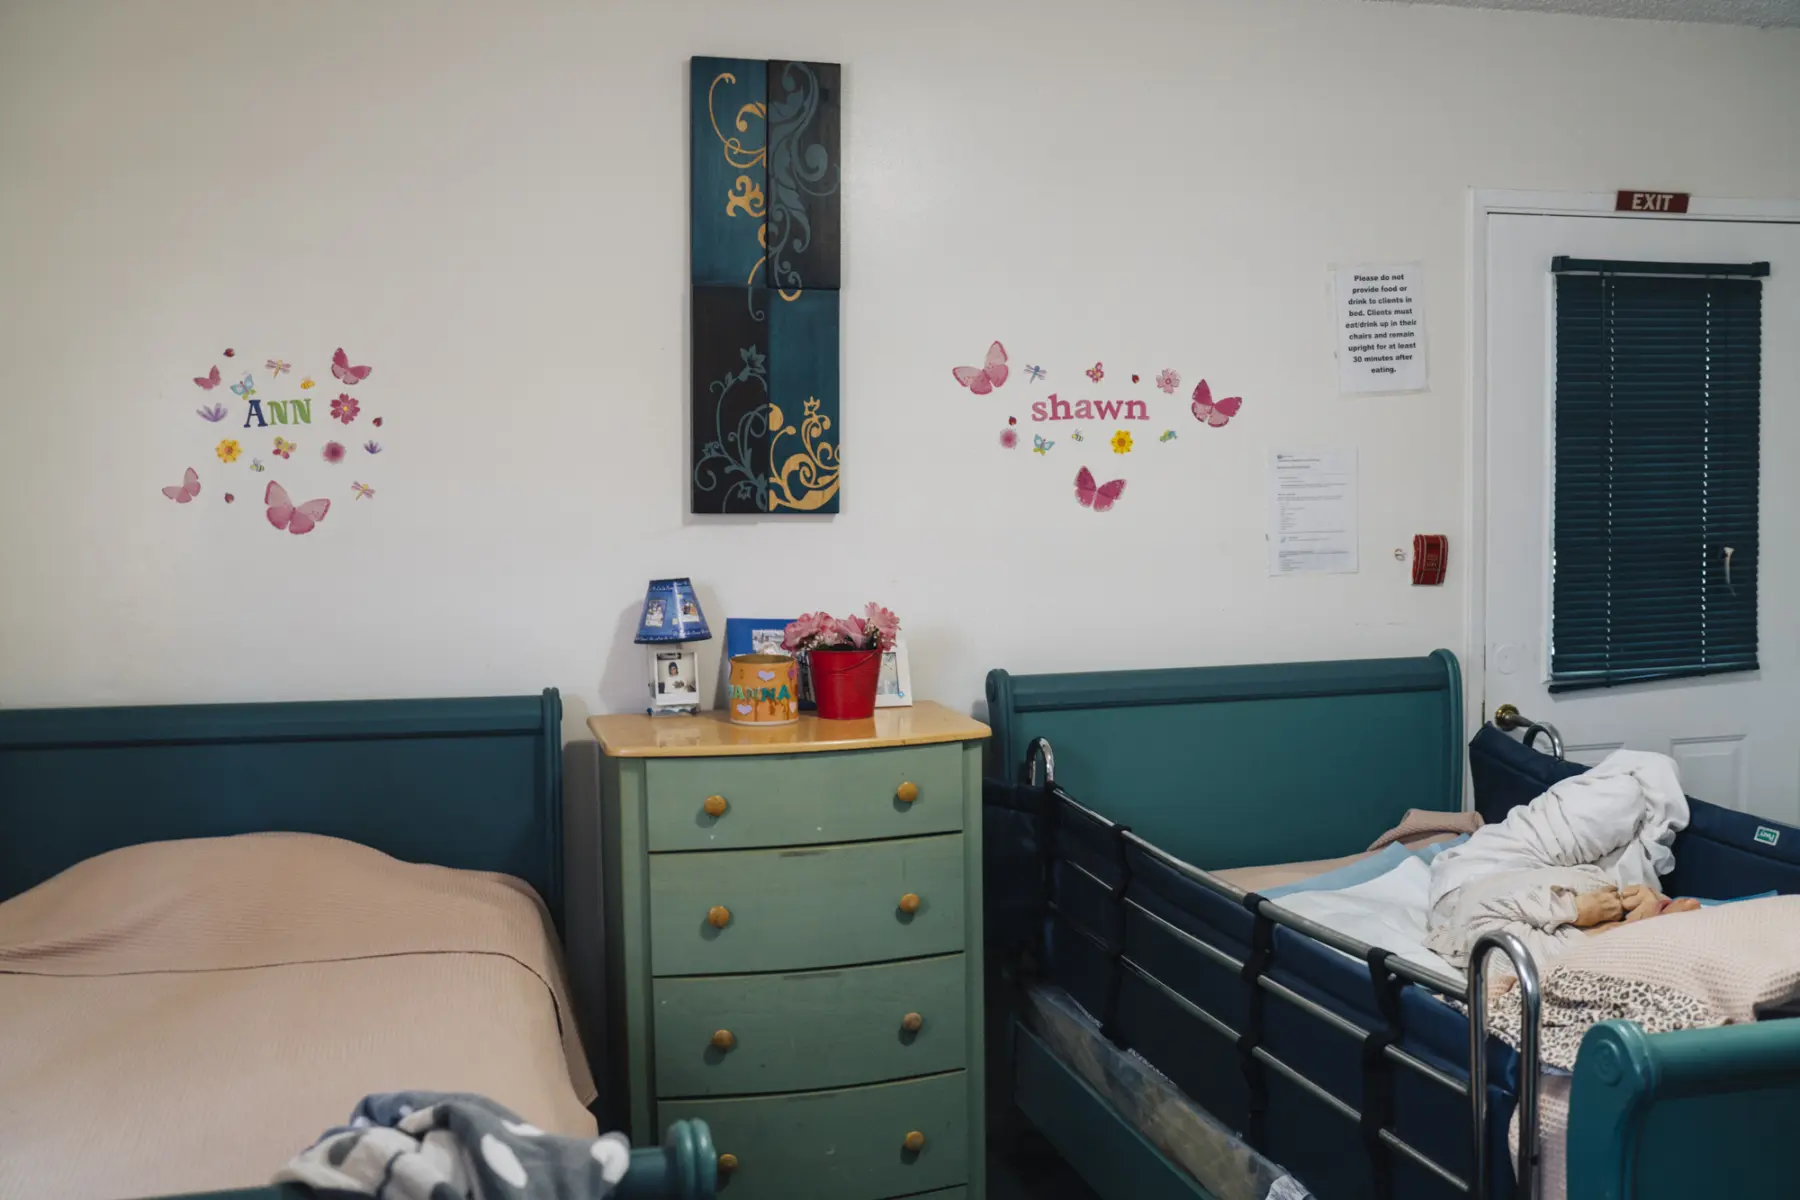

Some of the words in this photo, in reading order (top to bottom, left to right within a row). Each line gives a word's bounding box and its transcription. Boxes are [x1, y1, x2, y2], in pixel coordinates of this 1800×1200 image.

[1632, 192, 1674, 211] EXIT
[1352, 286, 1379, 294] provide
[1378, 296, 1403, 304] clients
[1366, 308, 1392, 316] Clients
[1399, 318, 1417, 326] their
[1348, 344, 1375, 352] upright
[1031, 393, 1150, 422] shawn
[244, 398, 312, 428] ANN
